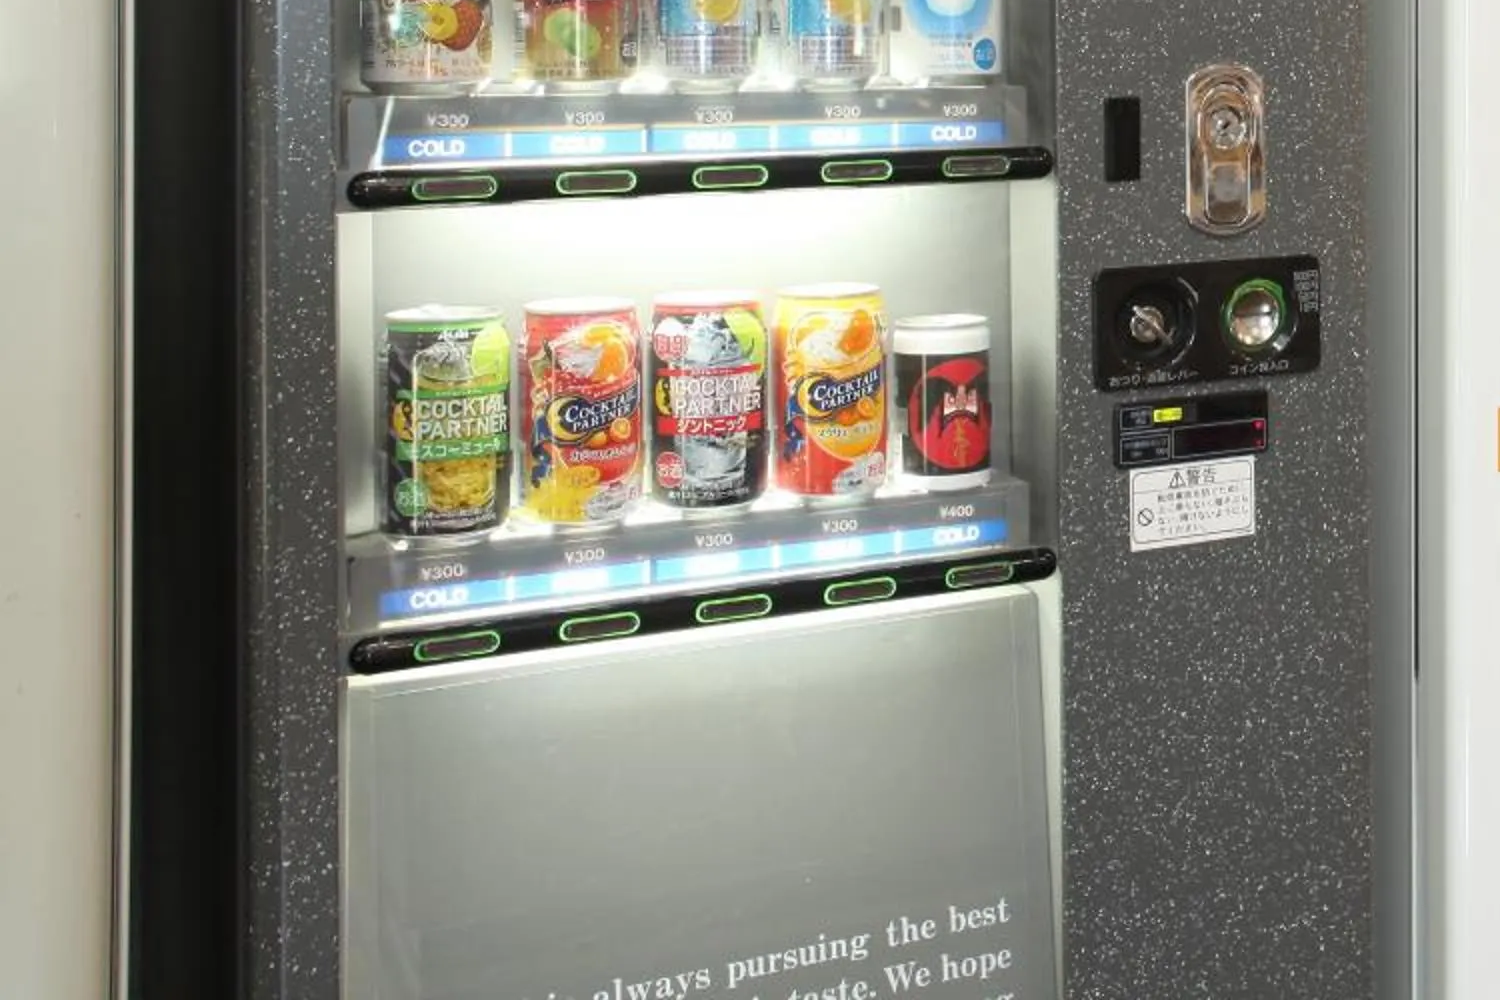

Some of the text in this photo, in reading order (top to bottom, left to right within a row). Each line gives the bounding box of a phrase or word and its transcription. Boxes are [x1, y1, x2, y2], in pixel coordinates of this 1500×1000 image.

[930, 124, 977, 142] COLD
[408, 138, 466, 157] COLD
[671, 376, 762, 397] COCKTAIL
[813, 368, 880, 402] COCKTAIL
[416, 393, 507, 421] COCKTAIL
[673, 393, 762, 417] PARTNER
[821, 385, 876, 411] PARTNER
[416, 413, 508, 441] PARTNER
[573, 403, 632, 433] PARTNER
[676, 417, 748, 434] ジントニック
[411, 437, 501, 458] スコーミュール
[1186, 468, 1217, 486] 警告
[409, 587, 468, 610] COLD
[727, 933, 872, 985] pursuing
[885, 916, 937, 948] the
[949, 897, 1011, 934] best
[884, 961, 931, 996] We
[940, 948, 1012, 985] hope
